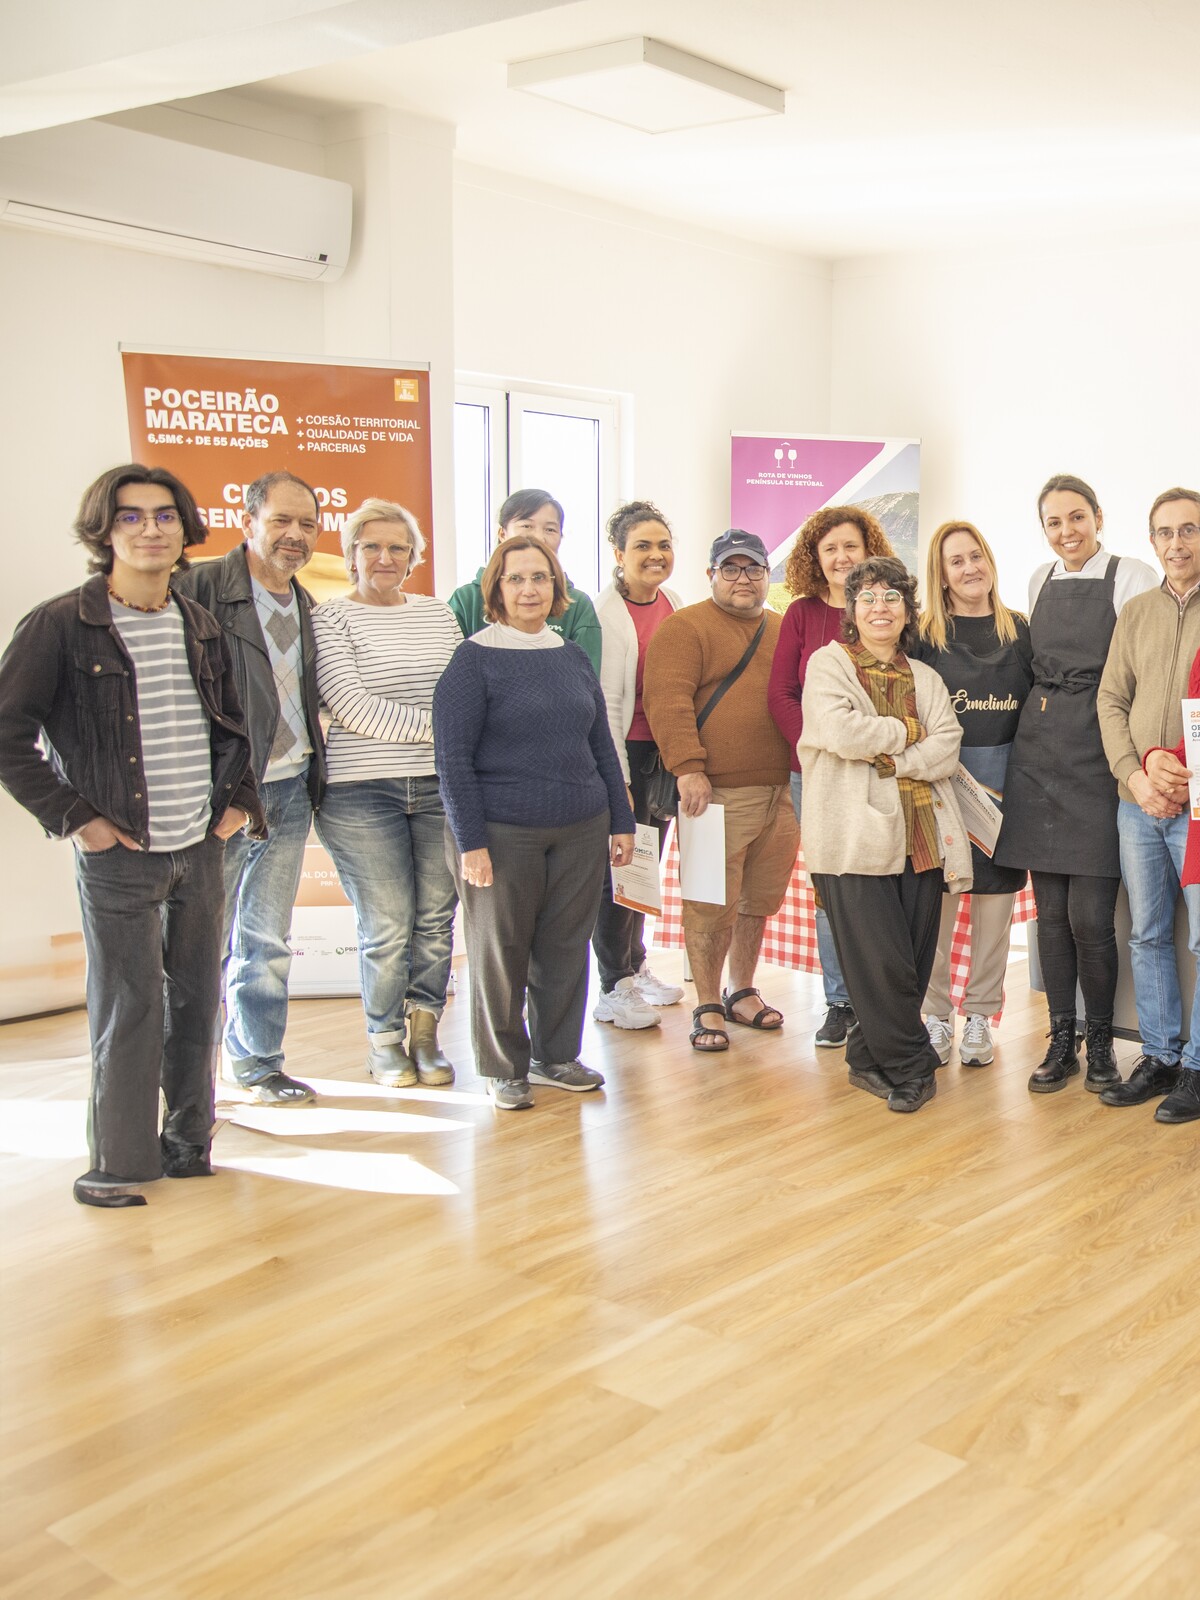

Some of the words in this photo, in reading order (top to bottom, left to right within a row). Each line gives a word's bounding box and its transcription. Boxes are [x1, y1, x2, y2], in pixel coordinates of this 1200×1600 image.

[144, 388, 279, 413] POCEIRÃO
[146, 409, 289, 435] MARATECA
[306, 414, 351, 426] COESÃO
[353, 417, 421, 429] TERRITORIAL
[148, 433, 183, 444] 6,5M€
[195, 435, 211, 445] DE
[213, 436, 228, 446] 55
[230, 436, 269, 449] AÇÕES
[306, 429, 369, 440] QUALIDADE
[372, 432, 386, 441] DE
[388, 432, 414, 442] VIDA
[307, 442, 366, 453] PARCERIAS
[746, 477, 783, 485] PENÍNSULA
